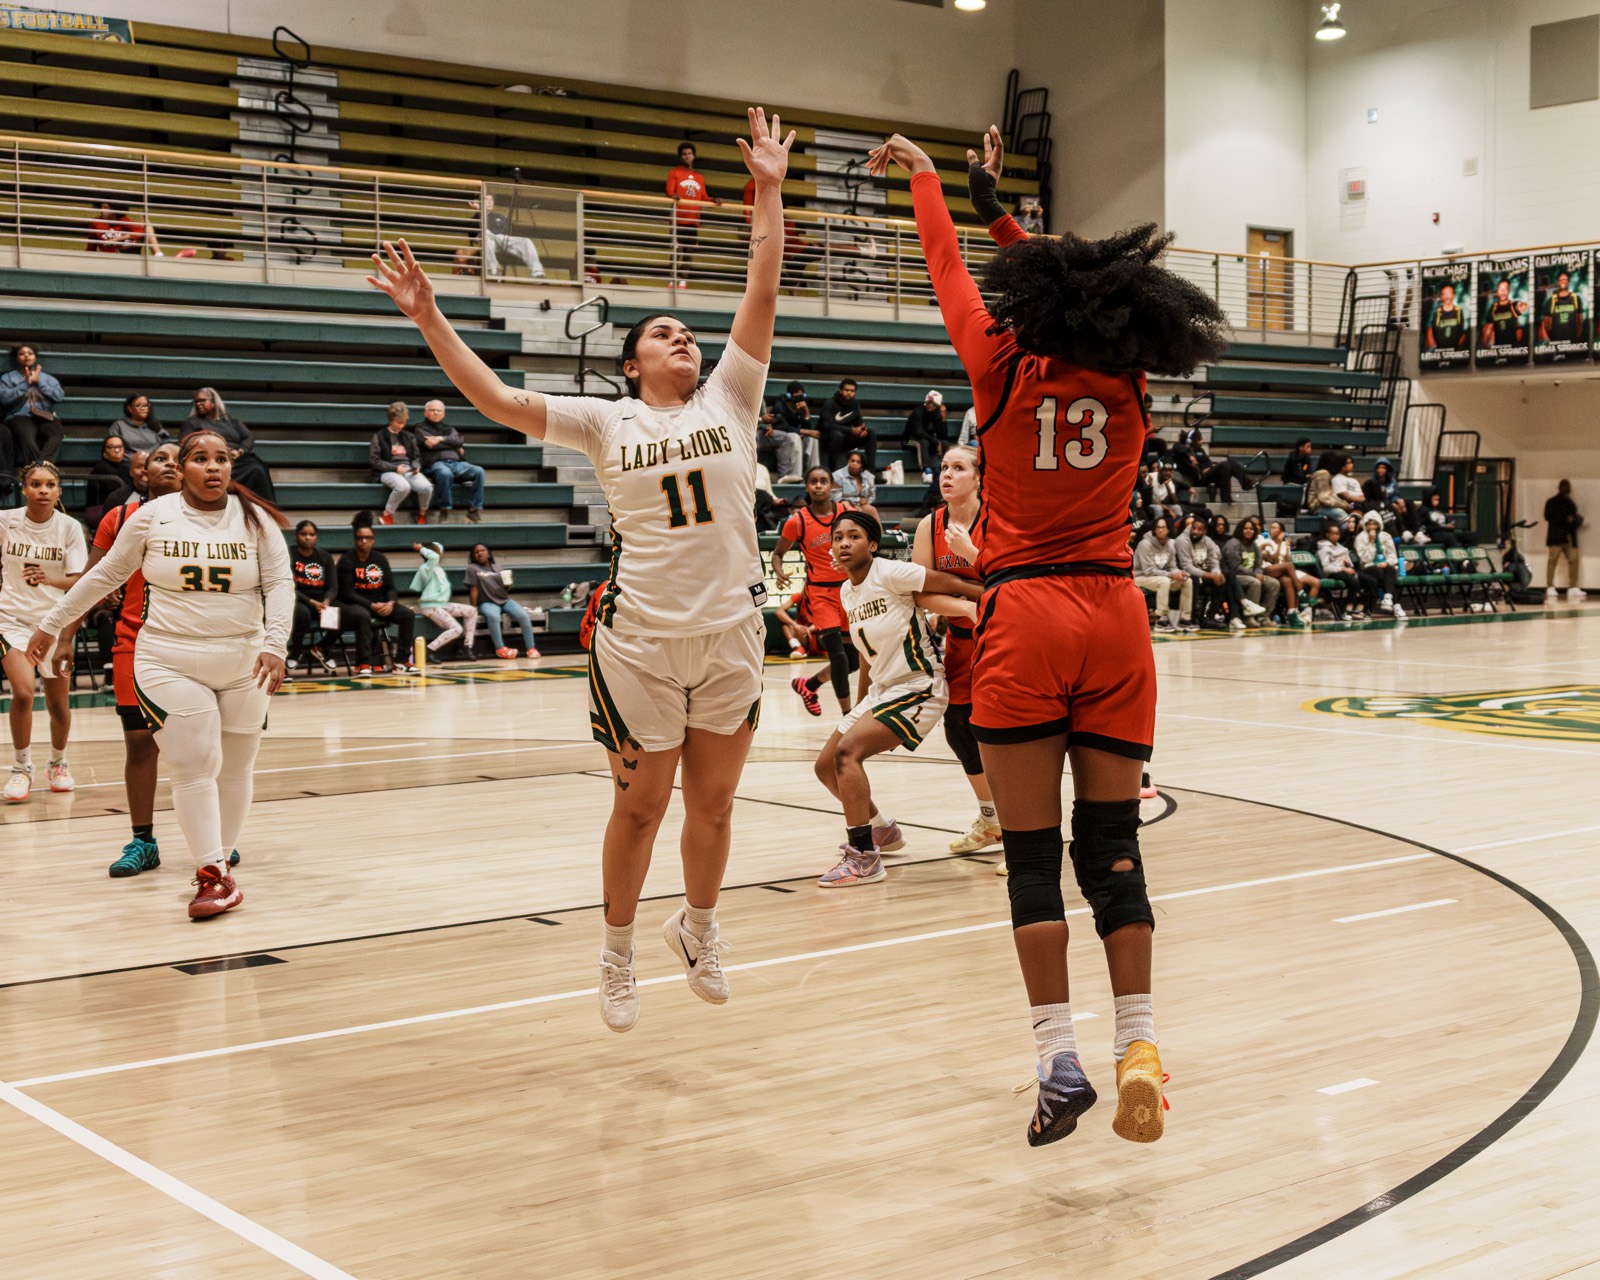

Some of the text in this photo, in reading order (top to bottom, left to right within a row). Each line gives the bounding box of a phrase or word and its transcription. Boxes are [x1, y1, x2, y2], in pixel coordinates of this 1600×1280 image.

[12, 10, 109, 31] FOOTBALL
[1034, 395, 1112, 471] 13
[620, 425, 733, 472] LADY LIONS
[659, 467, 715, 530] 11
[6, 540, 63, 561] LADY LIONS
[163, 540, 247, 560] LADY LIONS
[179, 564, 233, 594] 35
[754, 585, 763, 594] M
[858, 597, 888, 621] LIONS
[858, 627, 878, 658] 1
